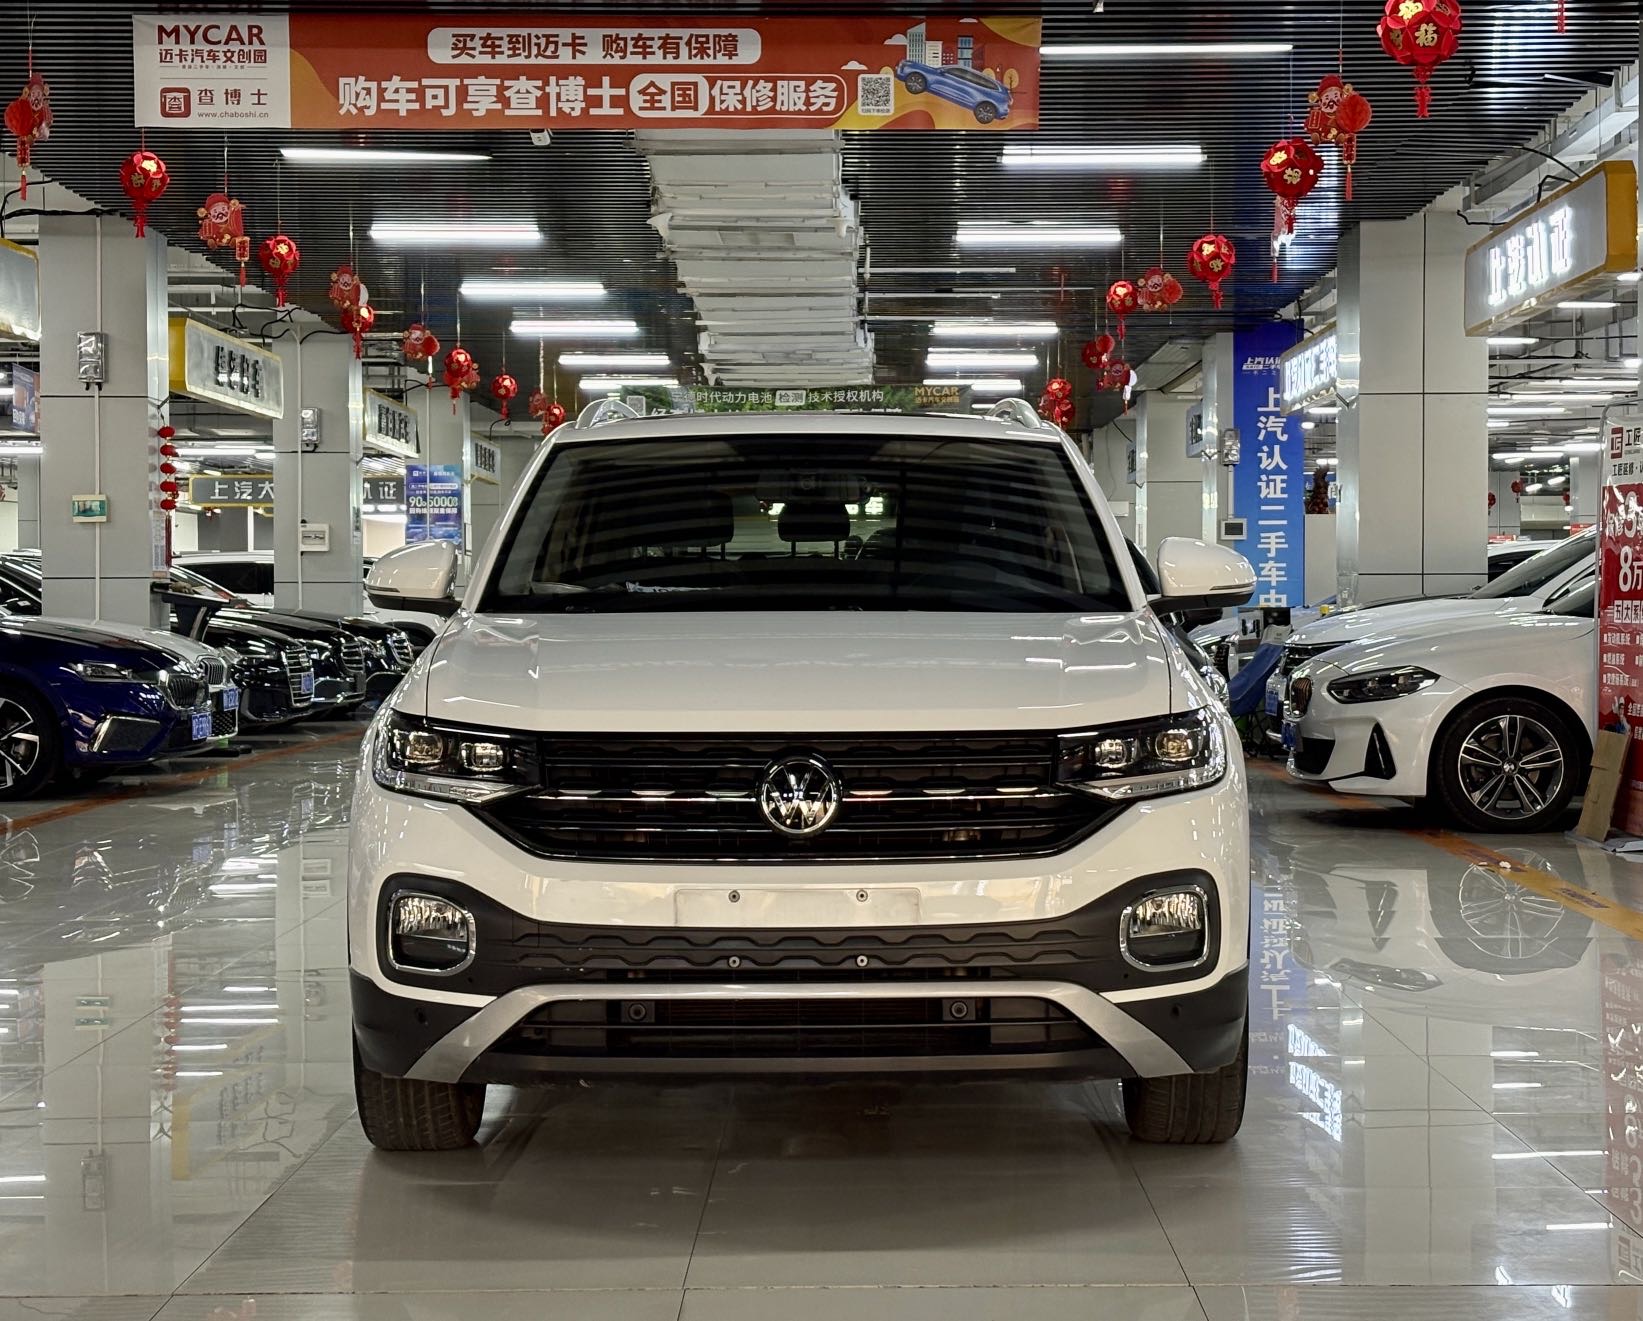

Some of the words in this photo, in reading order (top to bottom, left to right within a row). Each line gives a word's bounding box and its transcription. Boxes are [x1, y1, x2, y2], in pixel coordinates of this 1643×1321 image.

[157, 24, 266, 46] MYCAR
[450, 32, 589, 61] 买车到迈卡
[602, 32, 740, 61] 购车有保障
[158, 48, 268, 64] 迈卡汽车文创园
[197, 88, 269, 106] 查博士
[337, 76, 627, 117] 购车可享查博士
[637, 80, 701, 112] 全国
[710, 79, 840, 113] 保修服务
[197, 110, 269, 119] www.chaboshi.cn
[914, 386, 959, 396] MYCAR
